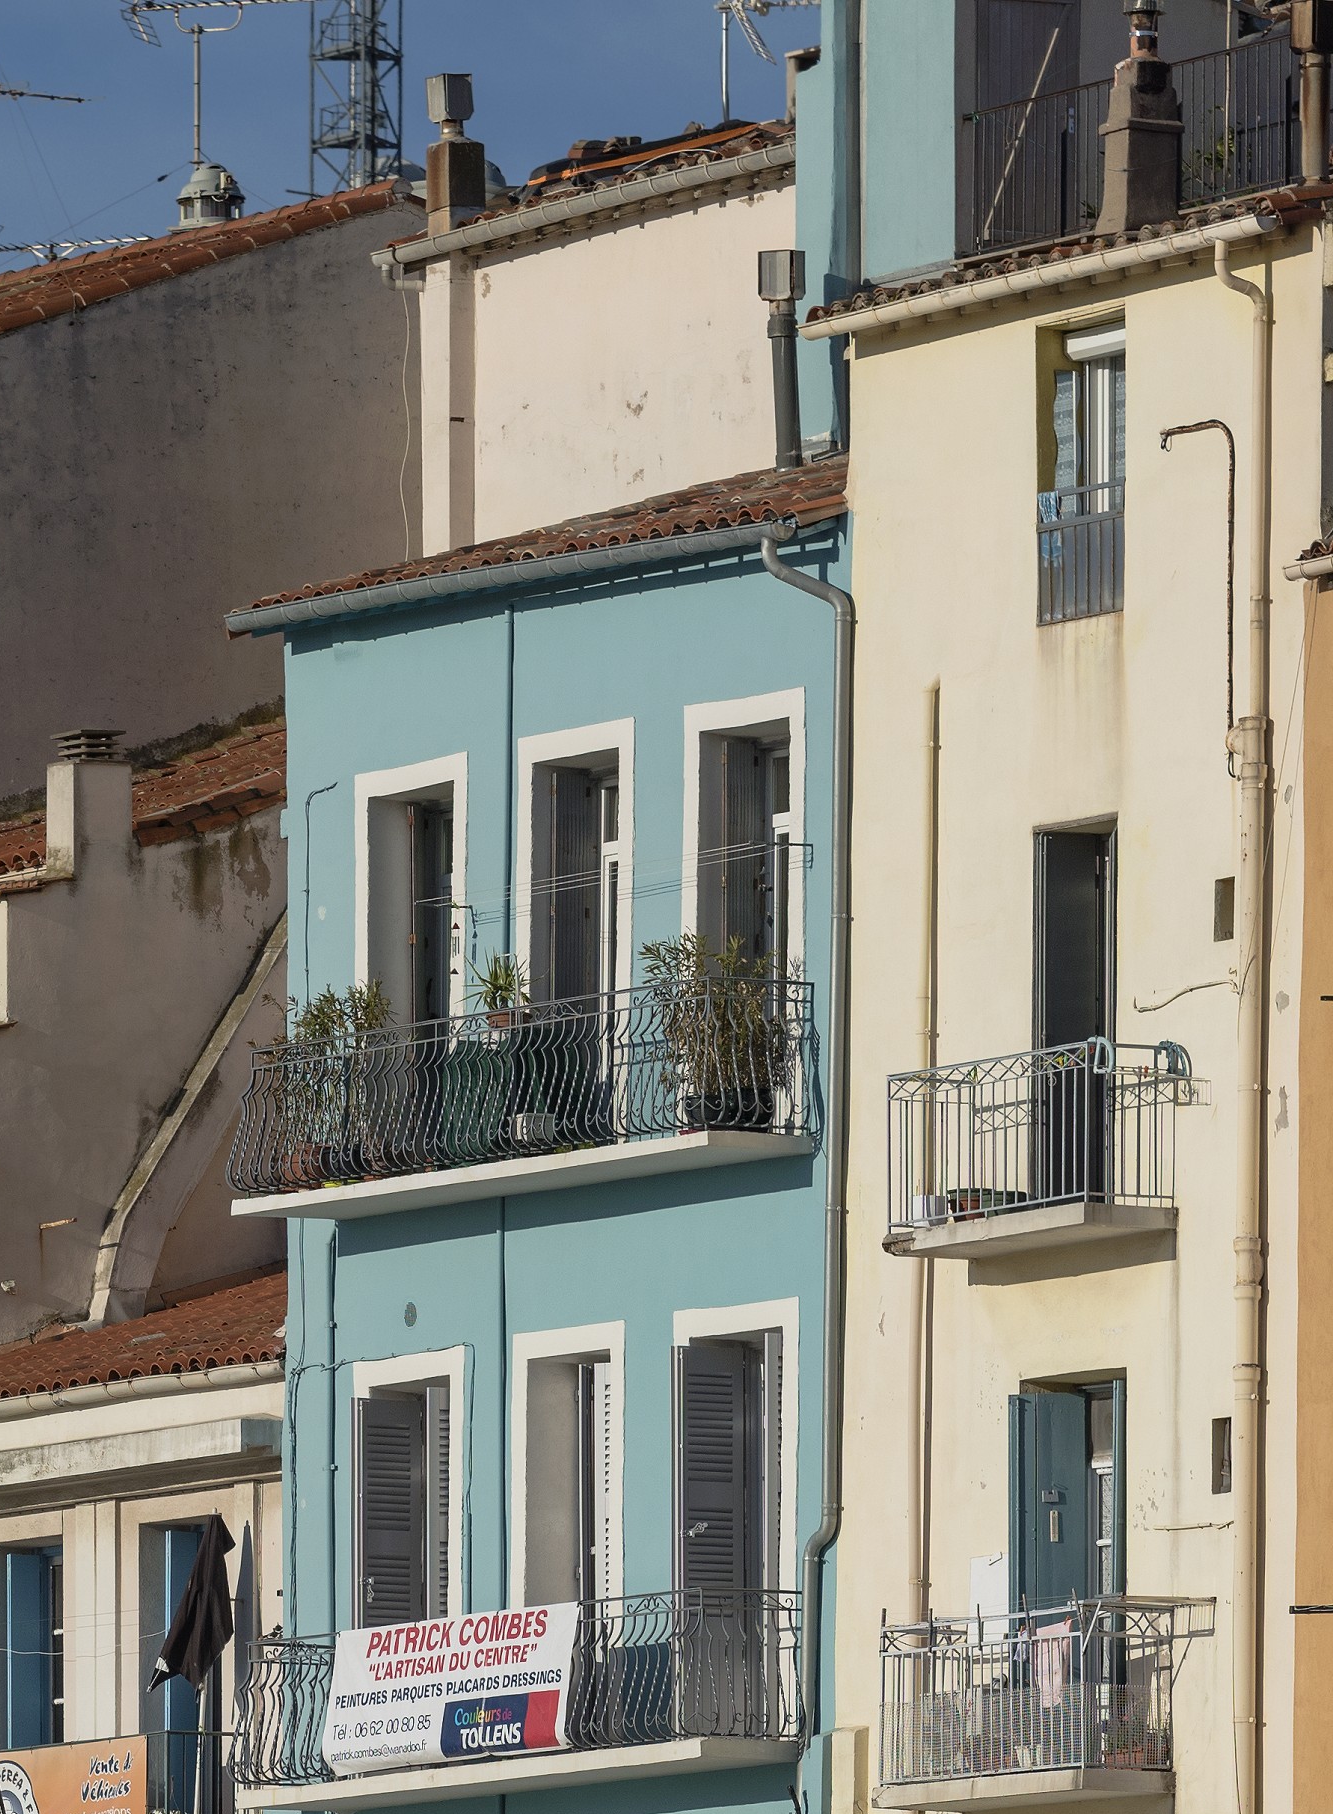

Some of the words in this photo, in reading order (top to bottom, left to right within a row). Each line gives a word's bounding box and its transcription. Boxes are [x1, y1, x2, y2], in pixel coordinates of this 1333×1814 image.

[366, 1620, 455, 1659] PATRICK
[459, 1609, 549, 1646] COMBES
[448, 1649, 472, 1672] DU
[335, 1690, 388, 1710] PEINTURES
[390, 1683, 443, 1704] PARQUETS
[446, 1675, 500, 1696] PLACARDS
[502, 1669, 562, 1689] DRESSINGS
[354, 1723, 368, 1738] 06
[367, 1721, 382, 1736] 62
[386, 1718, 401, 1734] 00
[401, 1716, 416, 1732] 80
[417, 1714, 431, 1731] 85
[454, 1708, 502, 1726] Couleurs
[502, 1709, 512, 1720] de
[460, 1723, 522, 1750] TOLLENS
[331, 1740, 427, 1764] patrick.combes@wanadoo.fr
[89, 1753, 120, 1777] Vente
[81, 1778, 132, 1803] Véhicules
